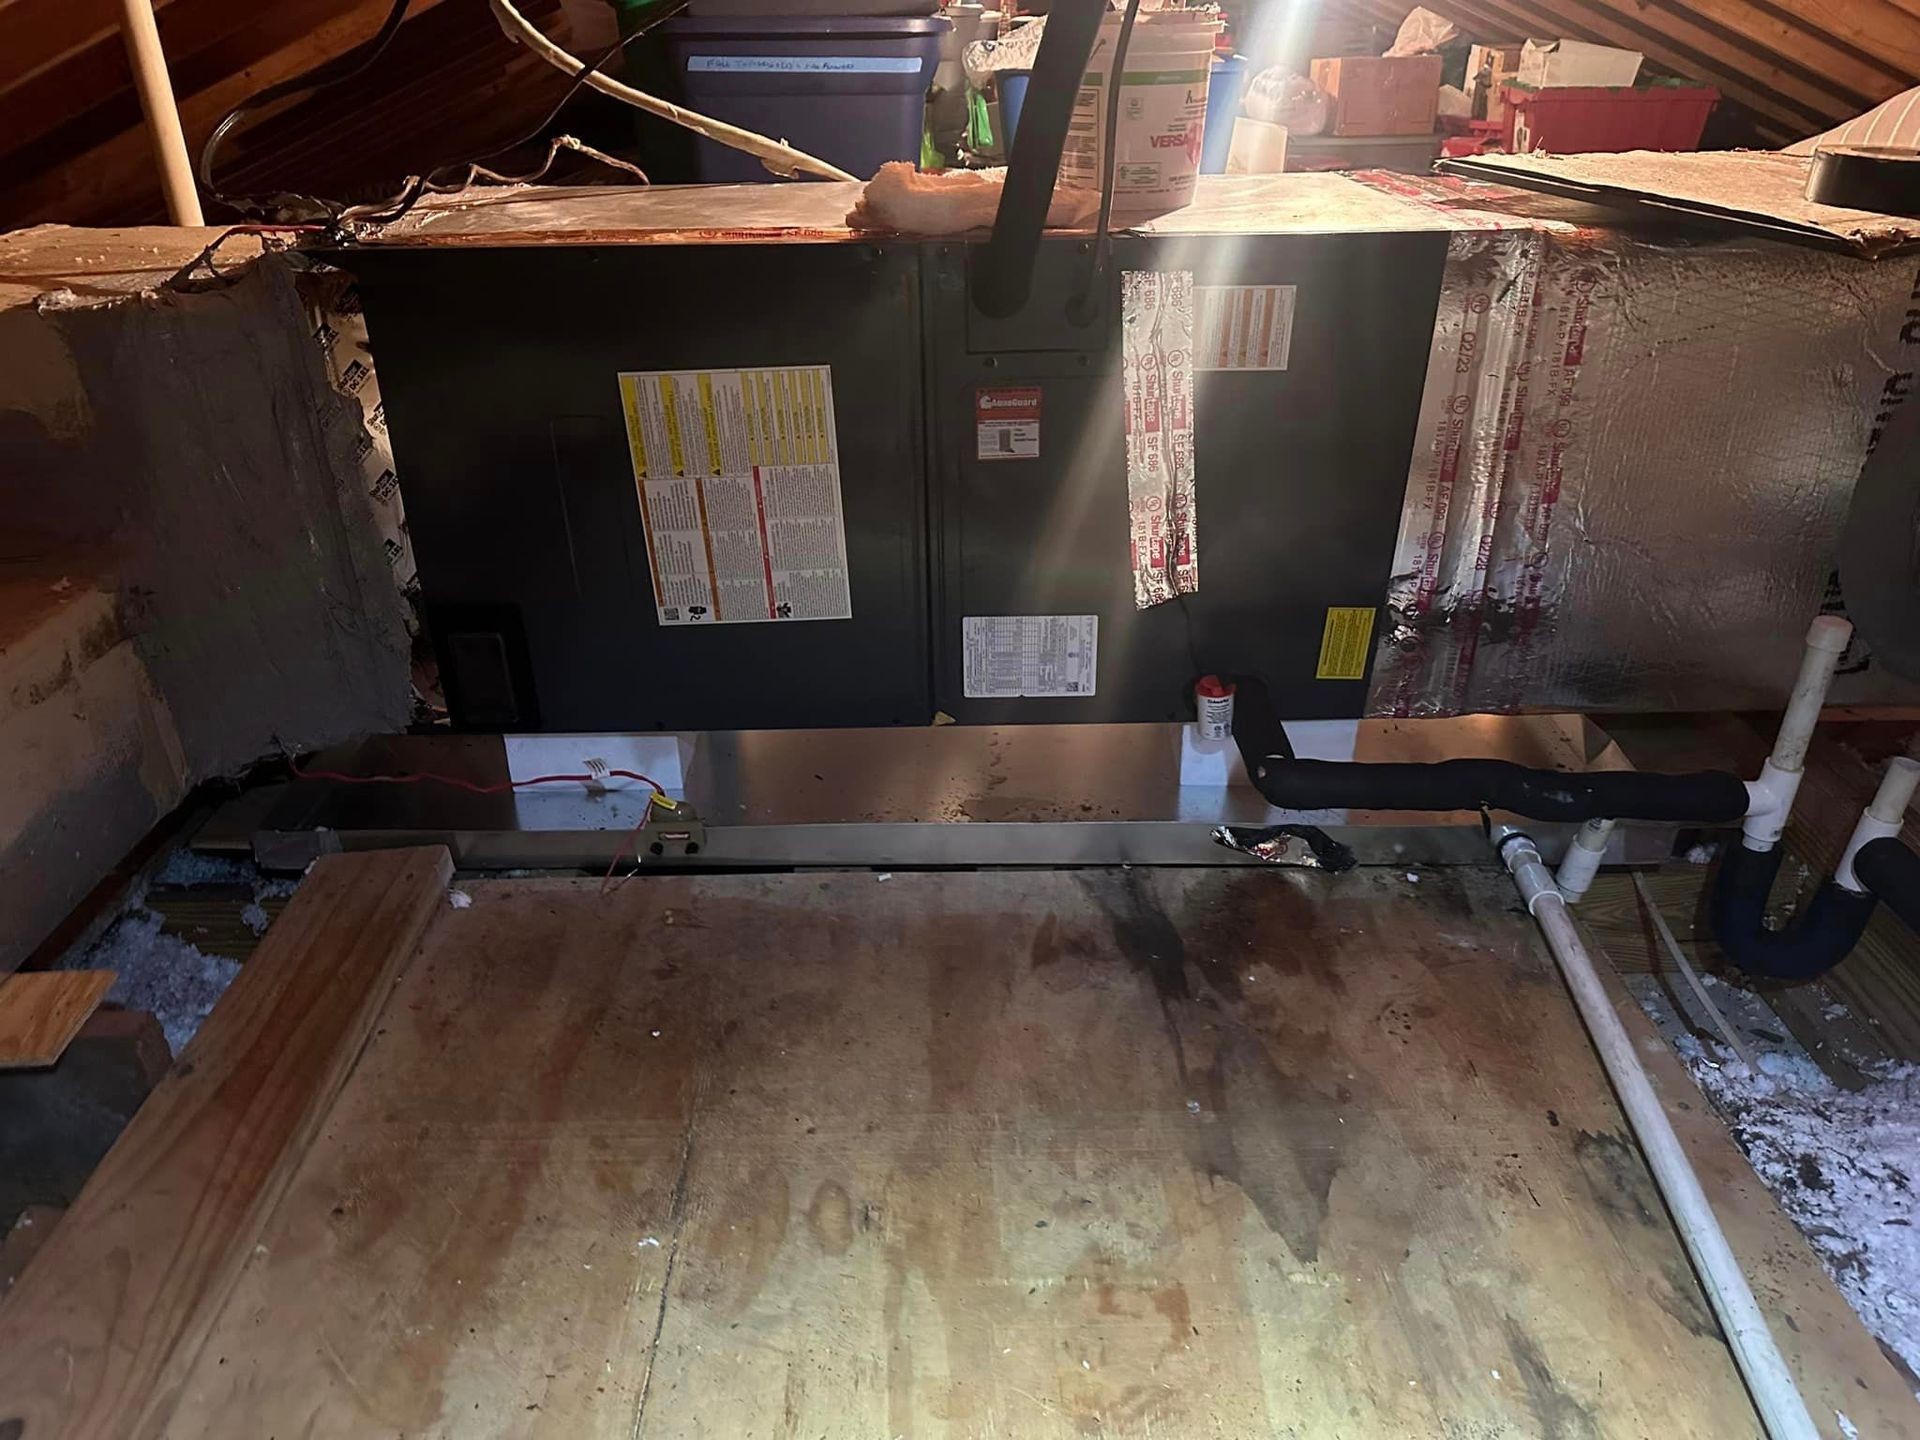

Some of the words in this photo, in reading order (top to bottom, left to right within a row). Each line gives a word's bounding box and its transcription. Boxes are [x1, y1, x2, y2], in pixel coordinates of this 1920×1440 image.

[1143, 290, 1155, 310] 686
[1455, 330, 1474, 374] Q2/23
[1144, 374, 1157, 422] Shurtape
[1146, 436, 1157, 450] SF
[1147, 453, 1159, 472] 686
[1438, 485, 1449, 500] AF
[1148, 515, 1162, 559] Shurtape
